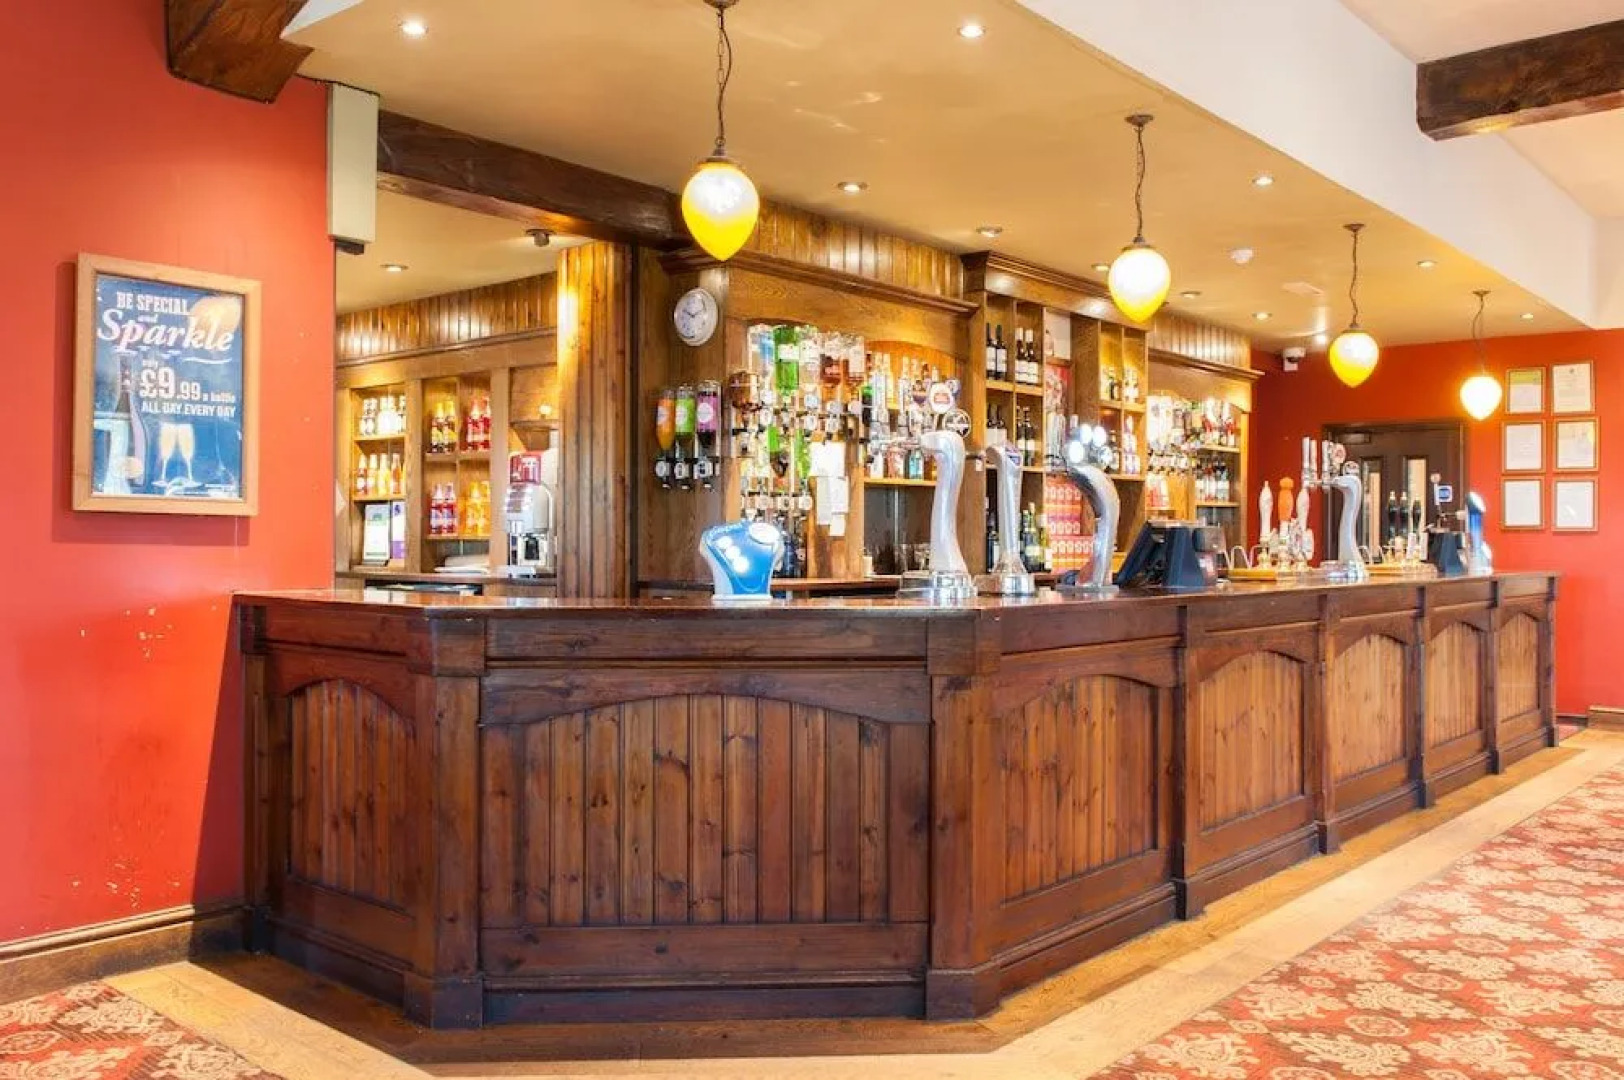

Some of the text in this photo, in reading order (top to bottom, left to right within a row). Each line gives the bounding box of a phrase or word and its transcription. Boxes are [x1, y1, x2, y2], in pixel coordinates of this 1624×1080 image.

[116, 291, 191, 315] BE SPECIAL
[97, 308, 234, 355] Sparkle
[142, 401, 236, 418] ALL DAY EVERY DAY
